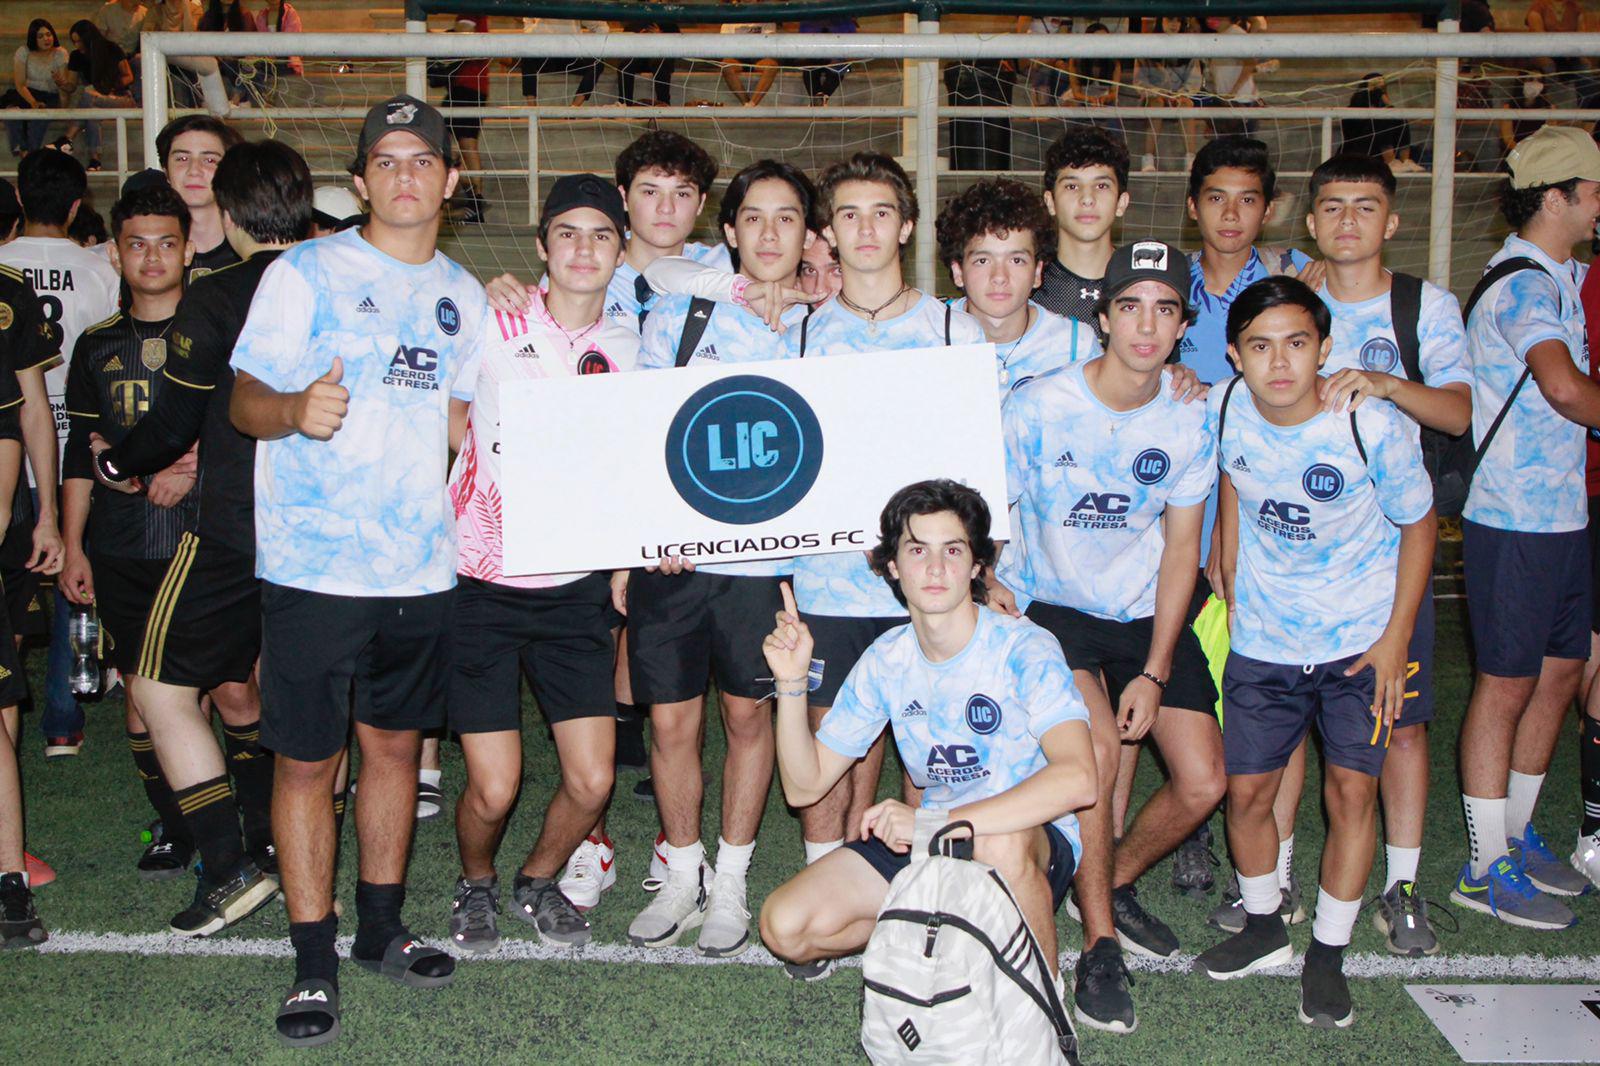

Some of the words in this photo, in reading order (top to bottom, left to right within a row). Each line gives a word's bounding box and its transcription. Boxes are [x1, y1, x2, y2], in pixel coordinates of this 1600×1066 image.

[440, 307, 456, 326] LIC
[389, 344, 438, 372] AC
[1366, 348, 1391, 366] LIC
[382, 376, 439, 391] CETRESA
[388, 368, 437, 381] ACEROS
[707, 420, 779, 471] LIC
[1139, 458, 1162, 475] LIC
[1311, 474, 1335, 492] LIC
[1070, 492, 1131, 515] AC
[1258, 498, 1311, 526] AC
[1063, 519, 1128, 529] CETRESA
[1068, 512, 1126, 522] ACEROS
[1259, 515, 1312, 533] ACEROS
[1257, 519, 1318, 541] CETRESA
[641, 533, 820, 560] LICENCIADOS
[831, 530, 865, 546] FC
[971, 706, 993, 723] LIC
[926, 744, 980, 768] AC
[927, 769, 991, 783] CETRESA
[928, 764, 984, 776] ACEROS
[285, 989, 328, 1007] FILA
